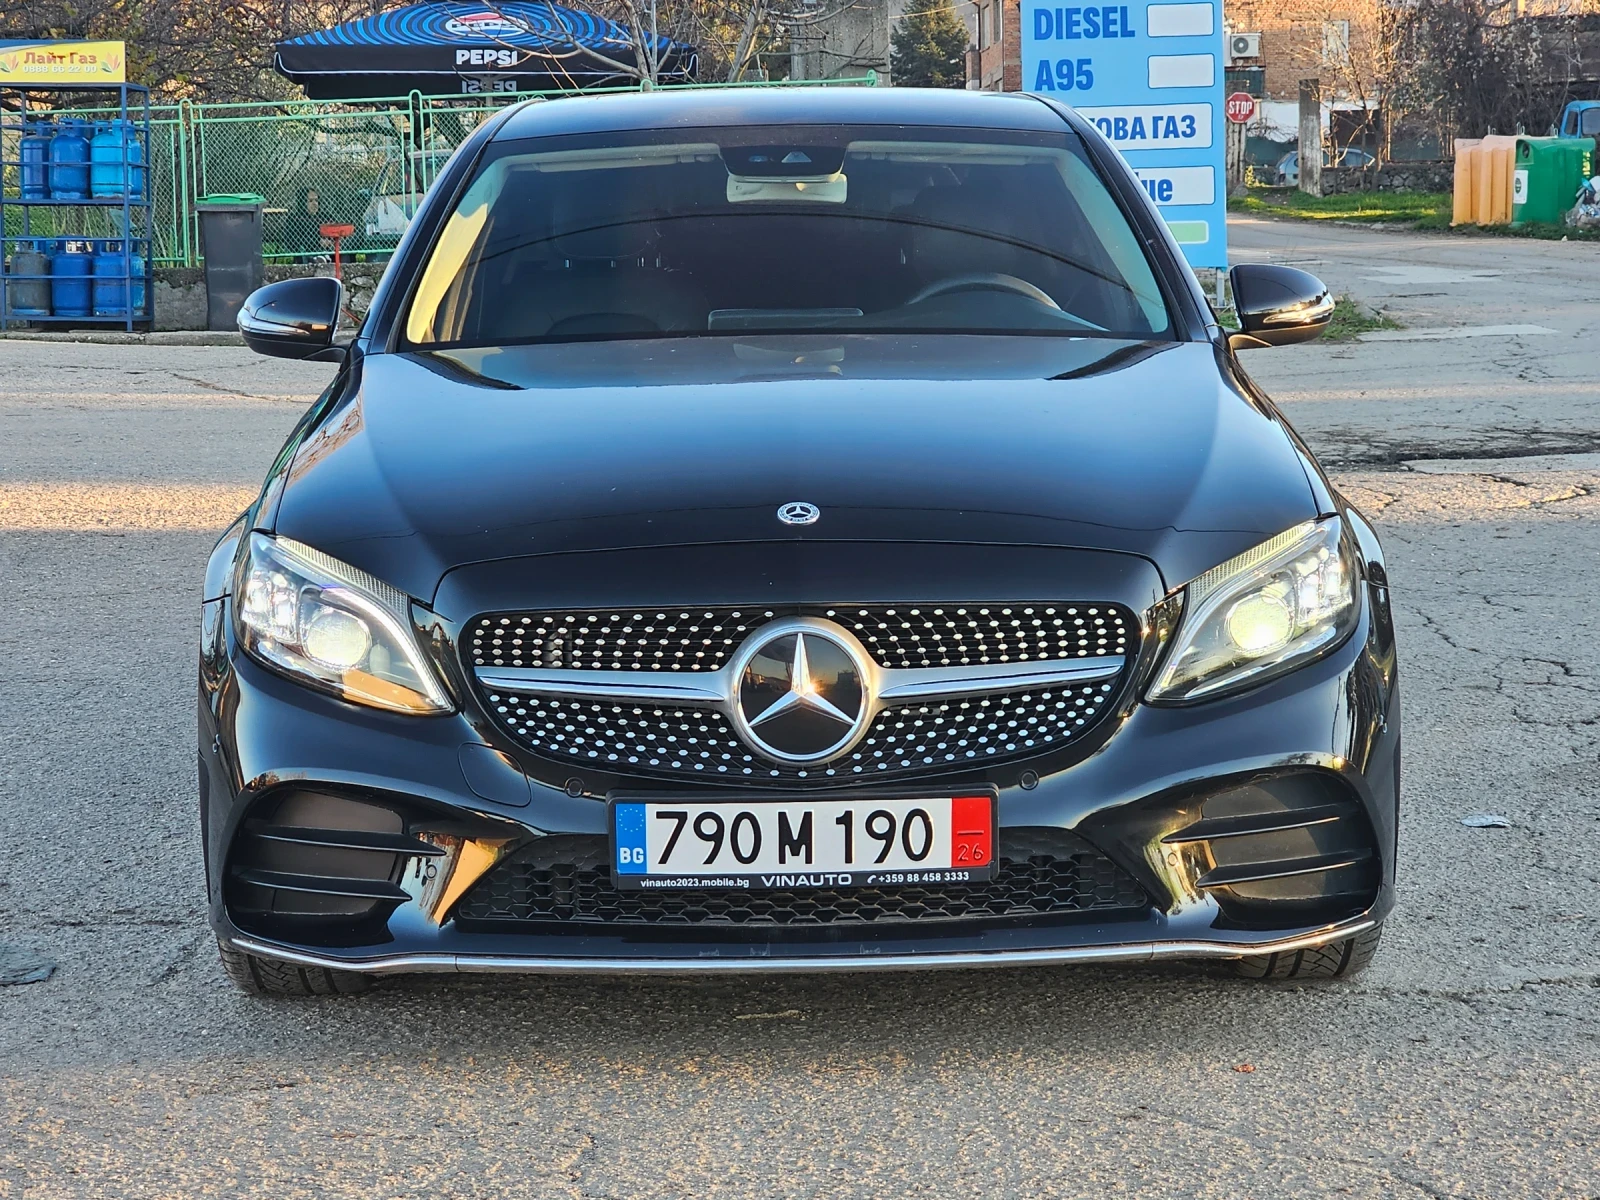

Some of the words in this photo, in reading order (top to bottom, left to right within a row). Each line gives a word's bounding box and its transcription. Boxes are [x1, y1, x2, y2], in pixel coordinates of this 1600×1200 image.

[1034, 6, 1135, 40] DIESEL
[24, 52, 66, 64] Лайт
[69, 52, 98, 64] Газ
[456, 49, 518, 65] PEPSI
[23, 65, 49, 73] 0888
[52, 65, 65, 73] 66
[68, 65, 81, 73] 22
[84, 65, 98, 73] 00
[1035, 58, 1094, 91] A95
[1228, 101, 1253, 115] STOP
[1089, 117, 1147, 140] ОВА
[1152, 114, 1197, 139] ГАЗ
[655, 810, 763, 865] 790
[778, 810, 813, 865] M
[835, 808, 934, 864] 190
[619, 847, 645, 864] BG
[957, 843, 984, 862] 26
[640, 878, 750, 888] vinauto2023.mobile.bg
[761, 873, 852, 888] VINAUTO
[878, 874, 904, 883] +359
[907, 873, 920, 882] 88
[922, 873, 941, 882] 458
[944, 871, 970, 882] 3333
